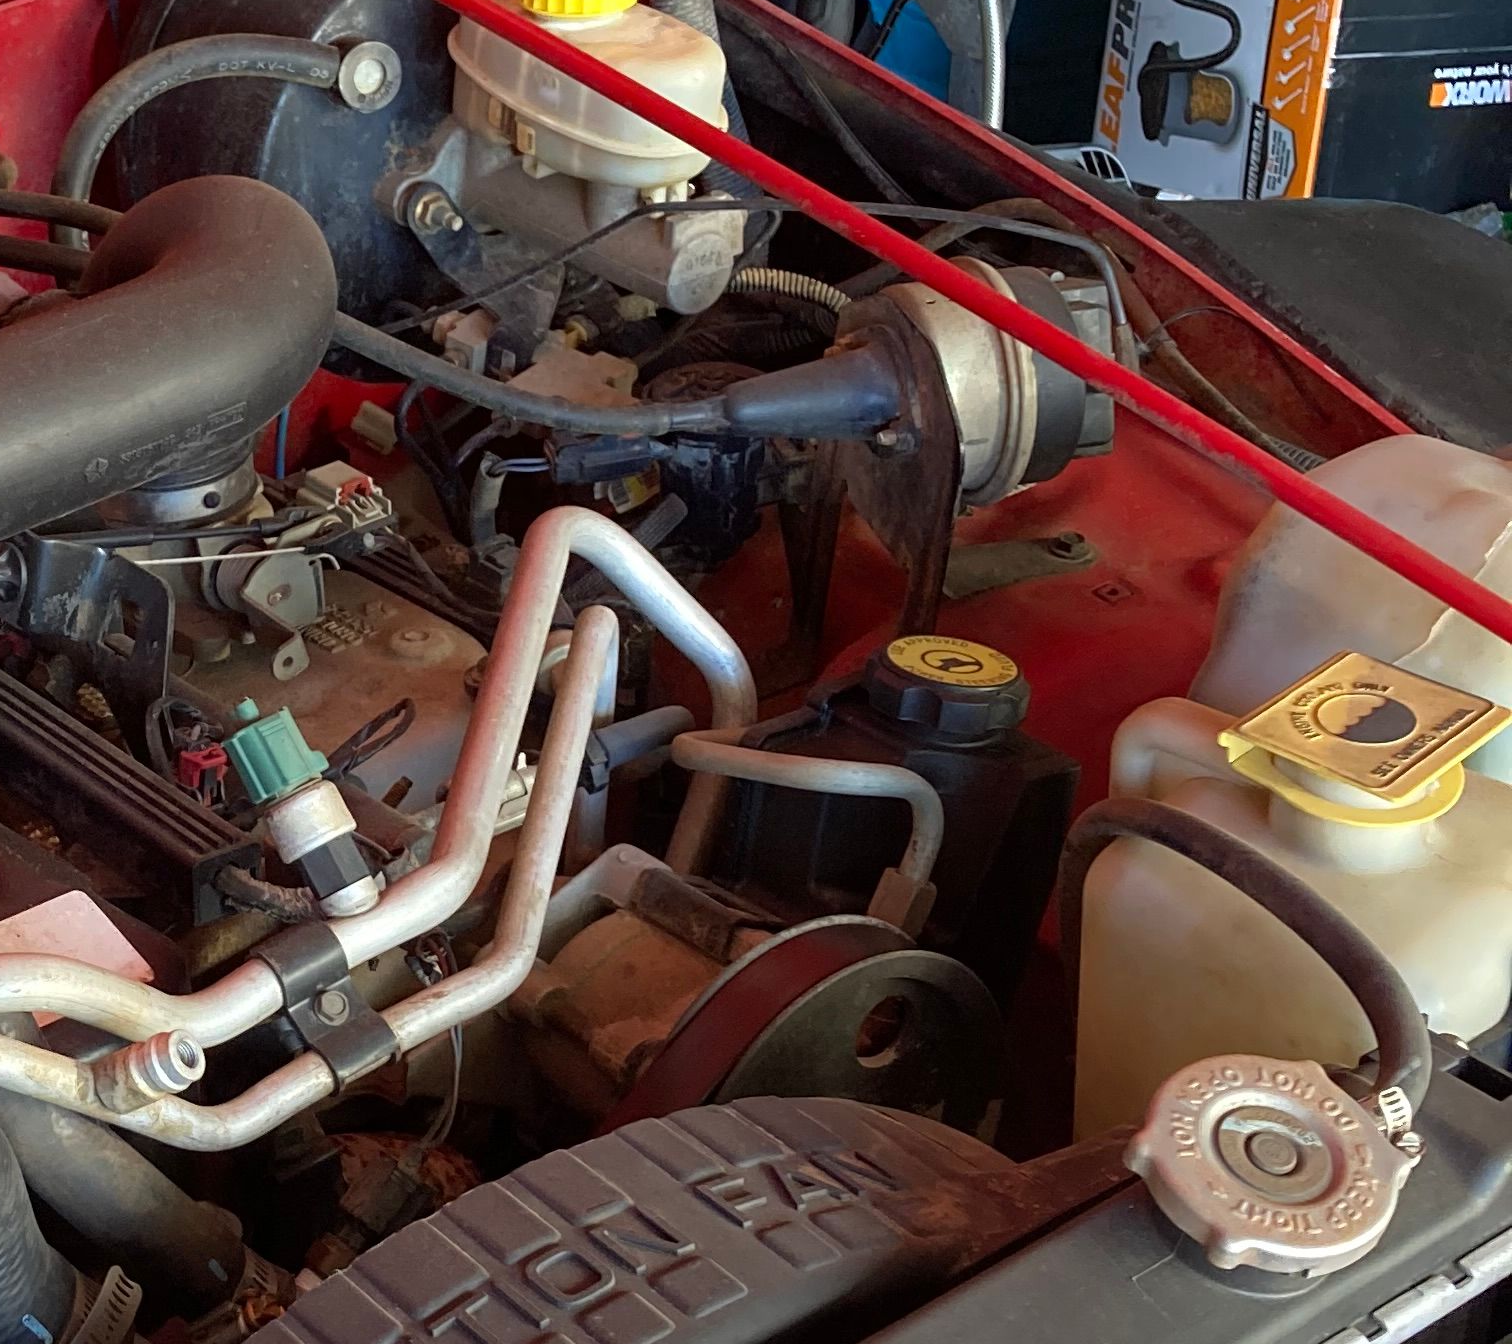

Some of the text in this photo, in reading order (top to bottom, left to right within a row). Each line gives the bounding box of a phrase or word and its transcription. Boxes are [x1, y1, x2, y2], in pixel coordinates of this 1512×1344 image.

[1441, 79, 1510, 107] WORX
[1177, 1067, 1245, 1109] OPEN
[1255, 1066, 1316, 1100] NOT
[1319, 1096, 1361, 1131] DO
[1170, 1112, 1199, 1159] HOT
[693, 1149, 905, 1229] FAN
[1229, 1171, 1381, 1235] KEEP TIGHT
